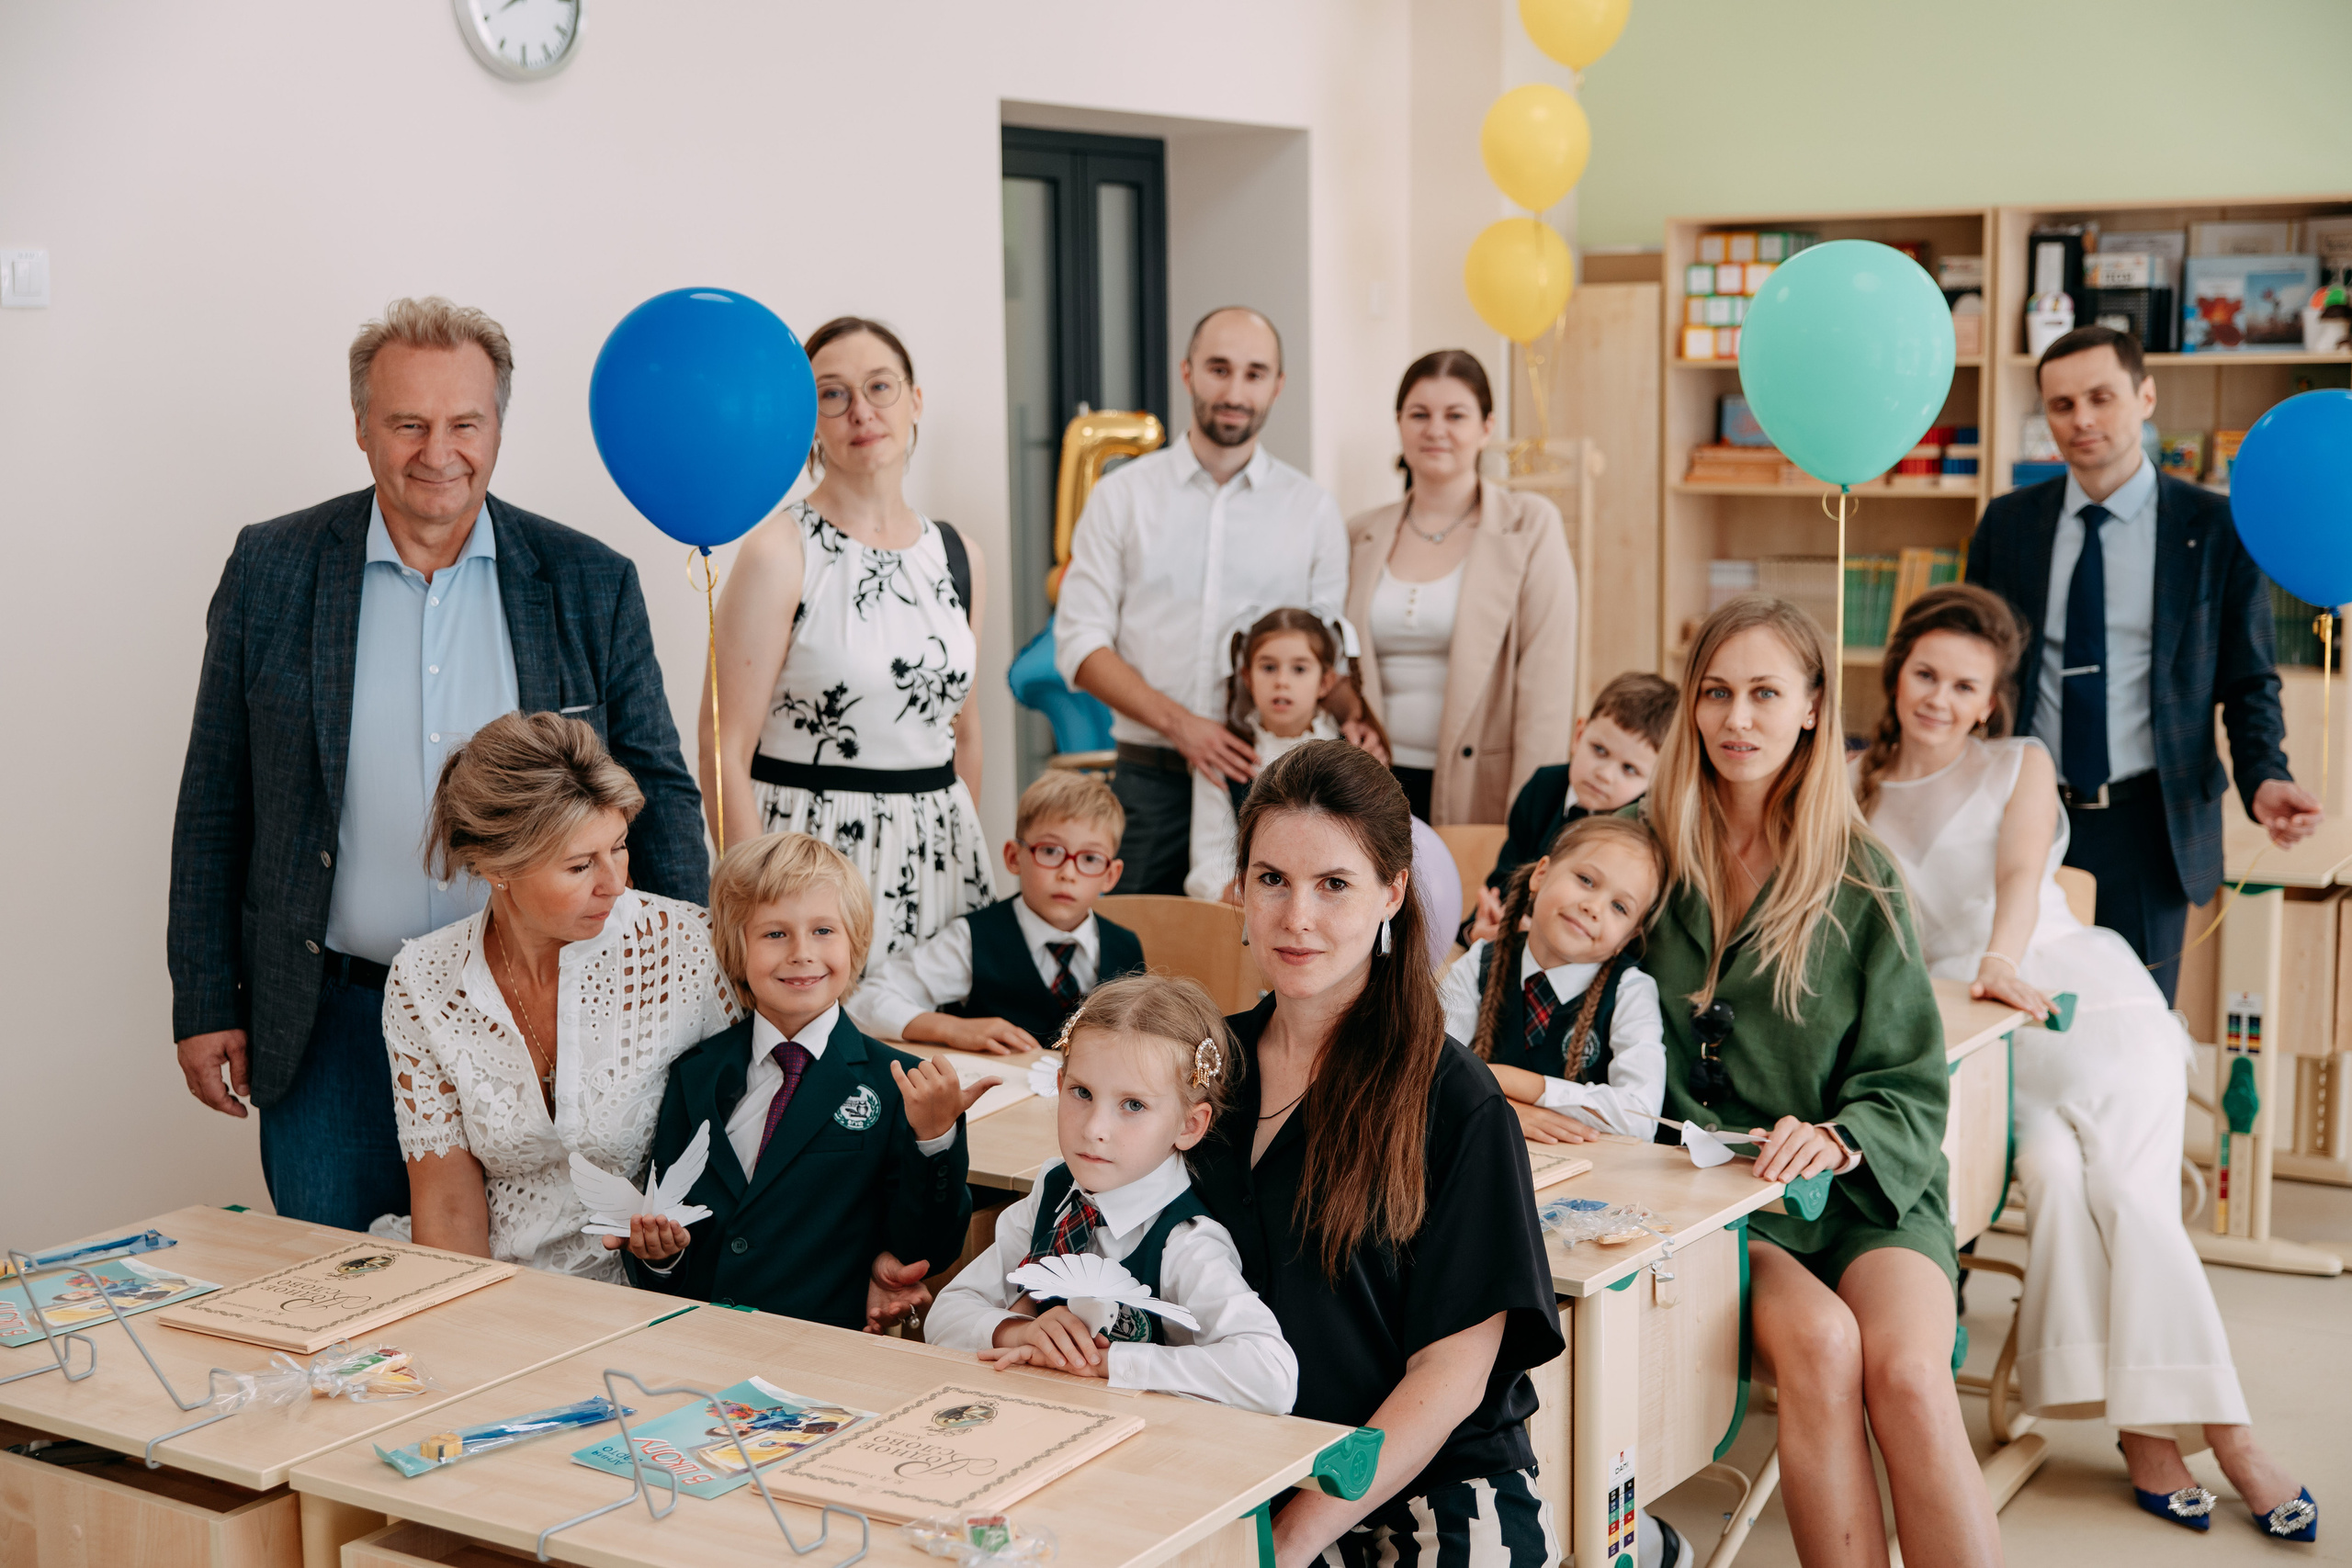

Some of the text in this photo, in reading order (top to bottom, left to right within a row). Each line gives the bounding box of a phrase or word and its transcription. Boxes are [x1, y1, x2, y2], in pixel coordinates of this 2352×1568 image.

[276, 1279, 341, 1295] СЛОВО
[873, 1435, 956, 1457] СЛОВО
[591, 1450, 626, 1466] Агния
[632, 1438, 702, 1475] ШКОЛУ
[681, 1473, 717, 1486] В
